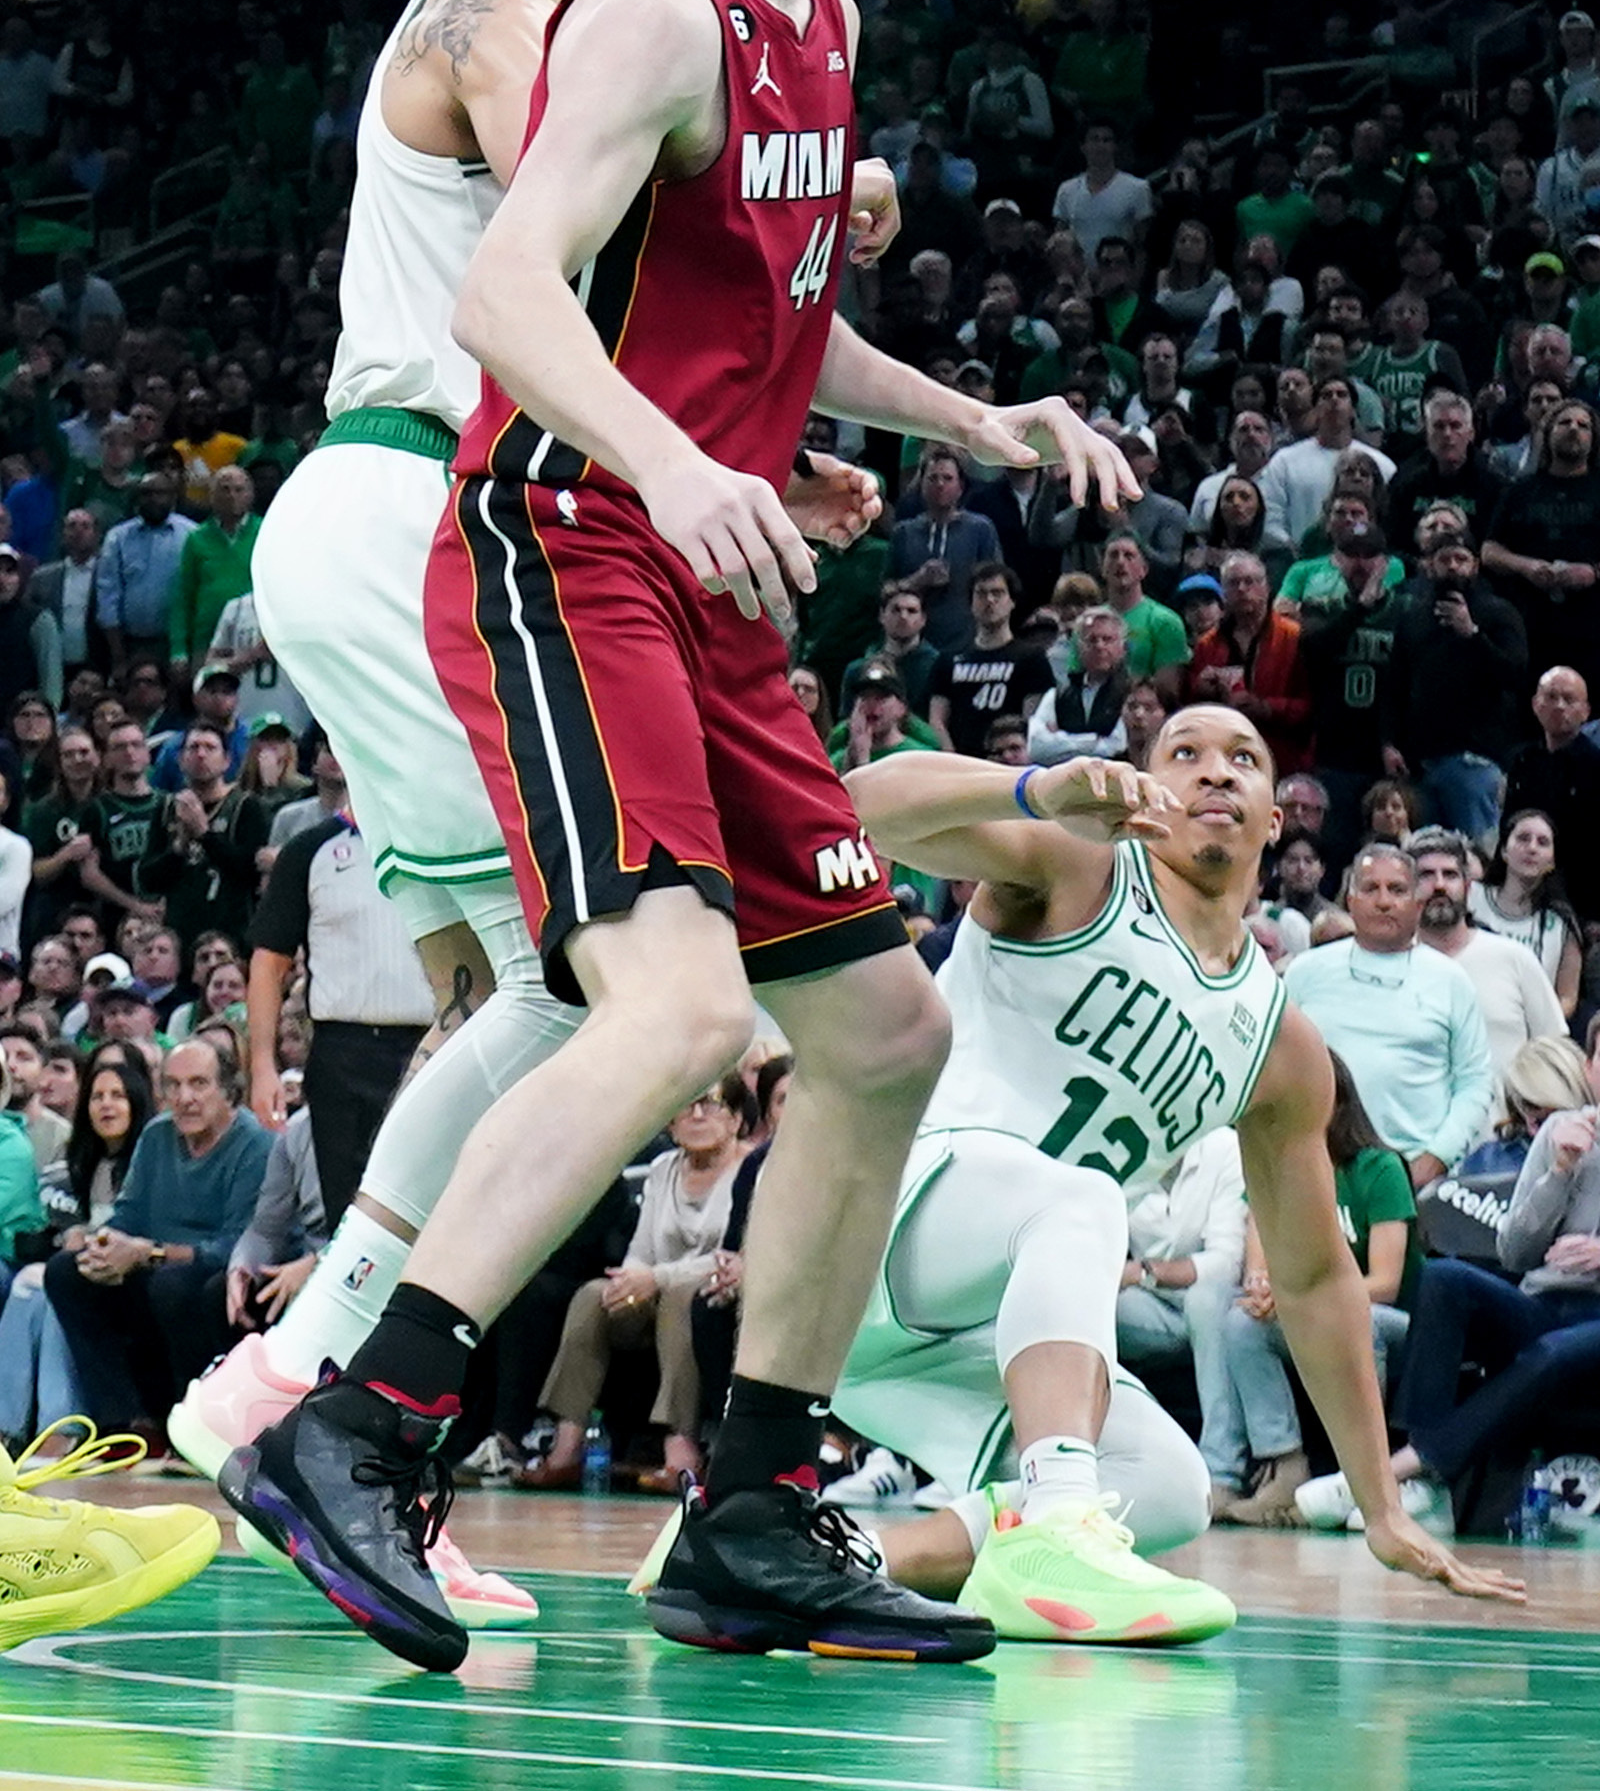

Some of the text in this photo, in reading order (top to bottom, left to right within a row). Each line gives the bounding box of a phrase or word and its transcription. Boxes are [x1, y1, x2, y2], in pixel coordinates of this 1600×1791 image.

[728, 8, 750, 42] 6
[741, 126, 846, 200] MIAM
[789, 212, 840, 311] 44
[952, 661, 1016, 683] MIAMI
[971, 682, 1008, 711] 40
[1054, 964, 1226, 1153] CELTICS
